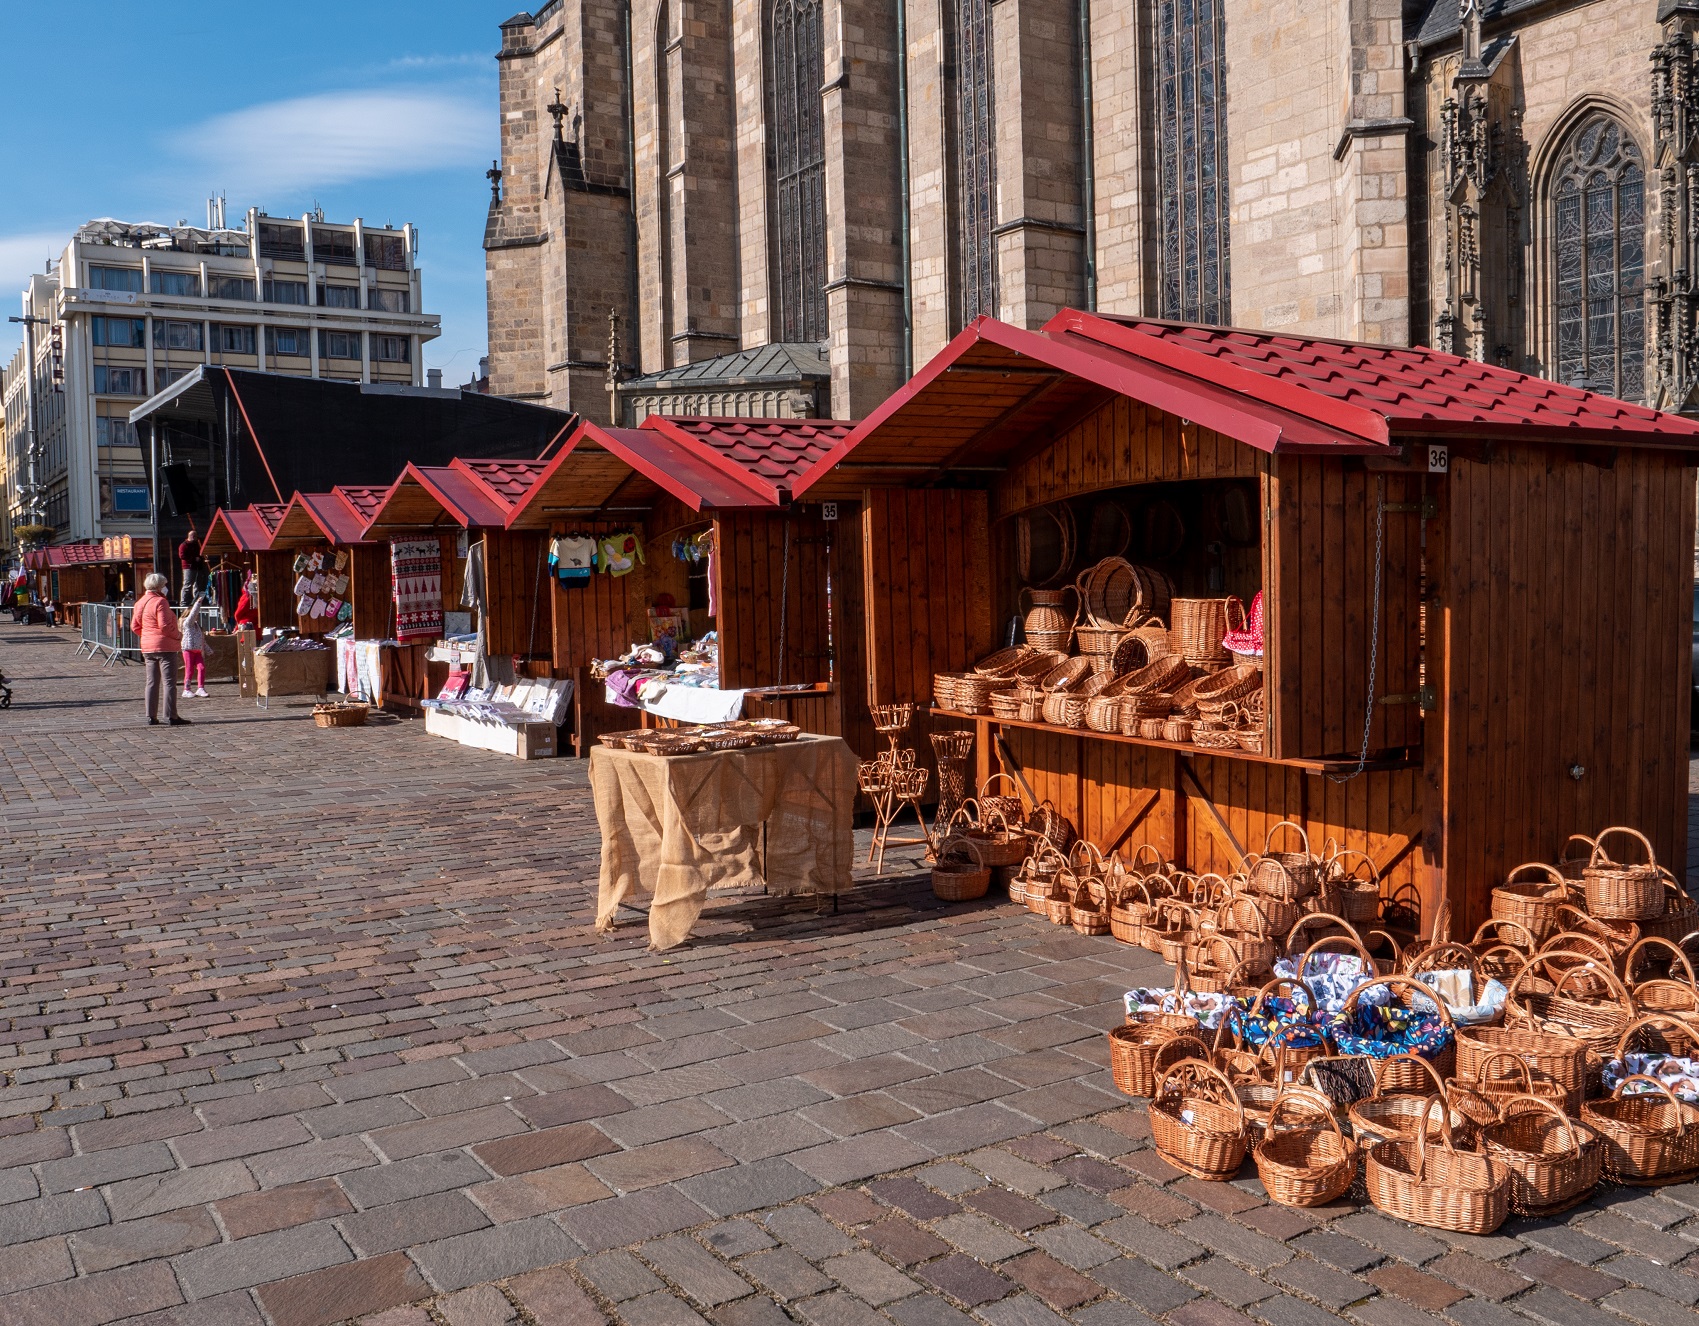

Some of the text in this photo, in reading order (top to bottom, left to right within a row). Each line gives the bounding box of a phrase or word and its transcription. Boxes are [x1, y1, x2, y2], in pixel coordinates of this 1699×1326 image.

[51, 324, 64, 393] HOTEL
[1430, 450, 1446, 467] 36
[824, 505, 835, 518] 35
